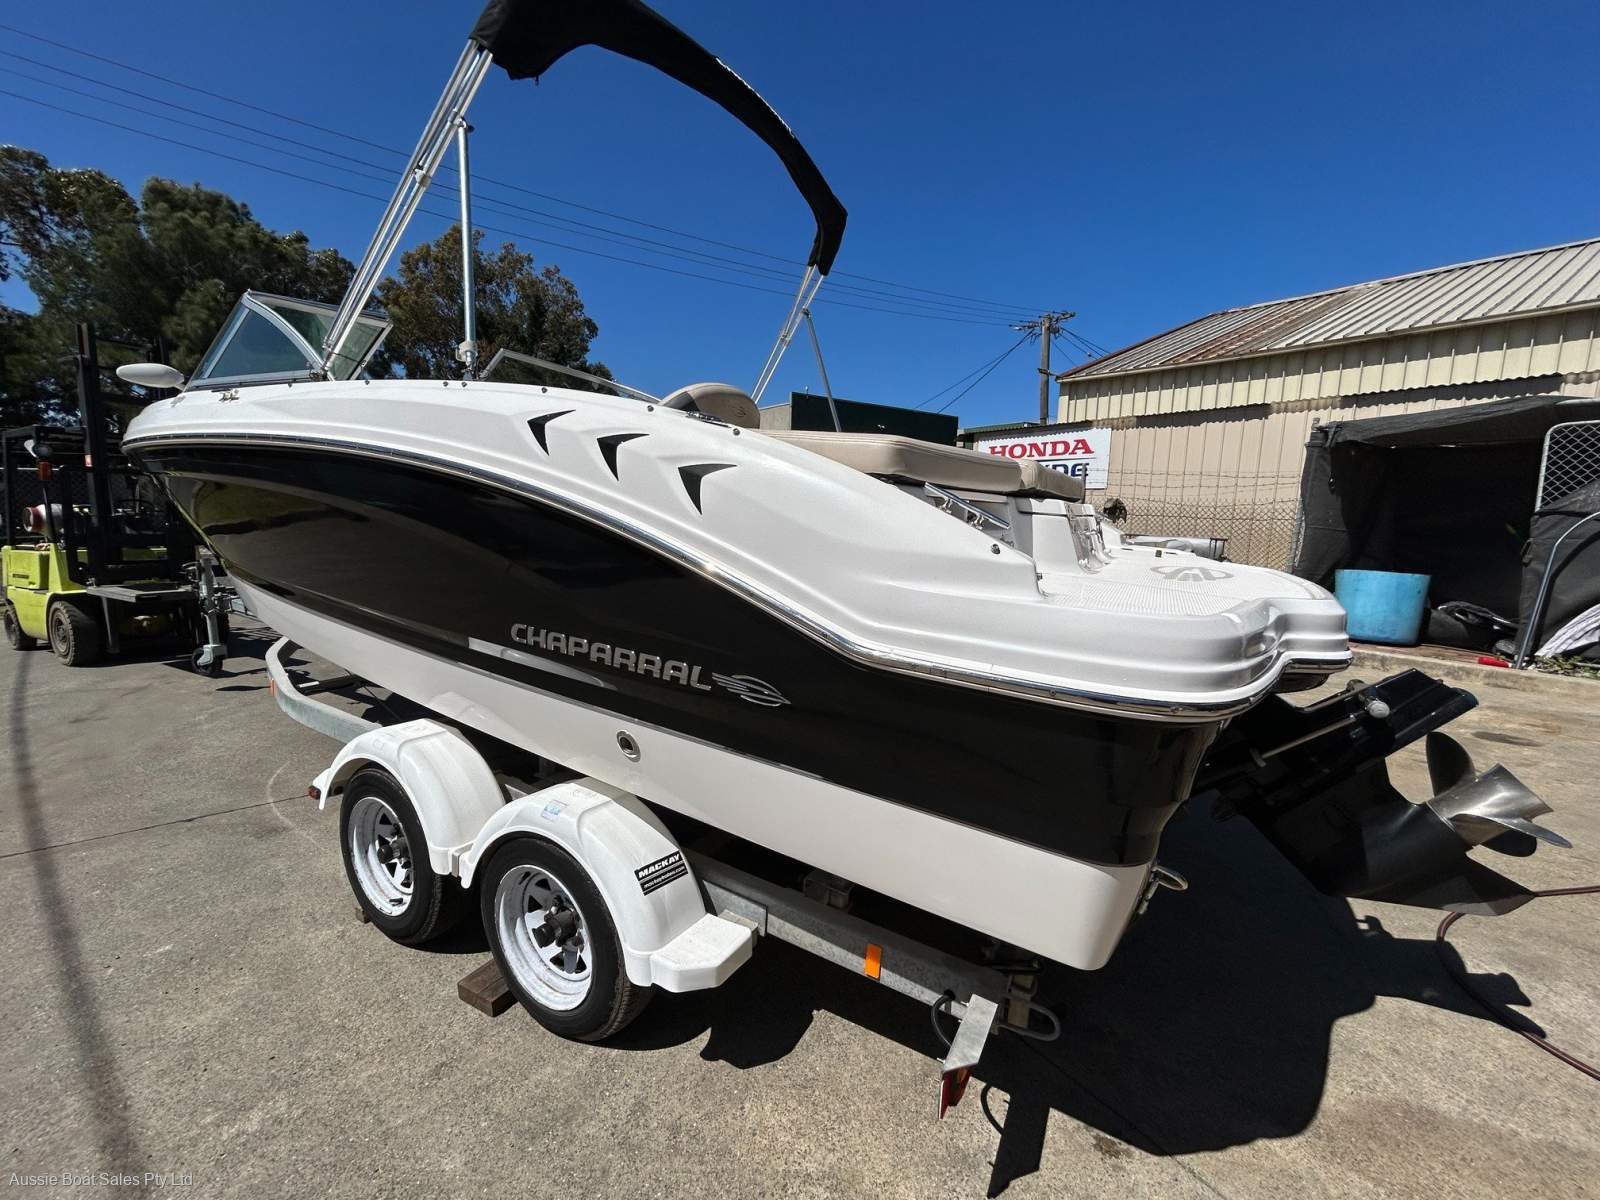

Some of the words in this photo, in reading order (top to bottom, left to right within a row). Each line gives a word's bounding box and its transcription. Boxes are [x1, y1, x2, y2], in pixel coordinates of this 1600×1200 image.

[989, 438, 1094, 459] HONDA
[510, 623, 712, 691] CHAPARRAL
[638, 853, 681, 878] MACKAY
